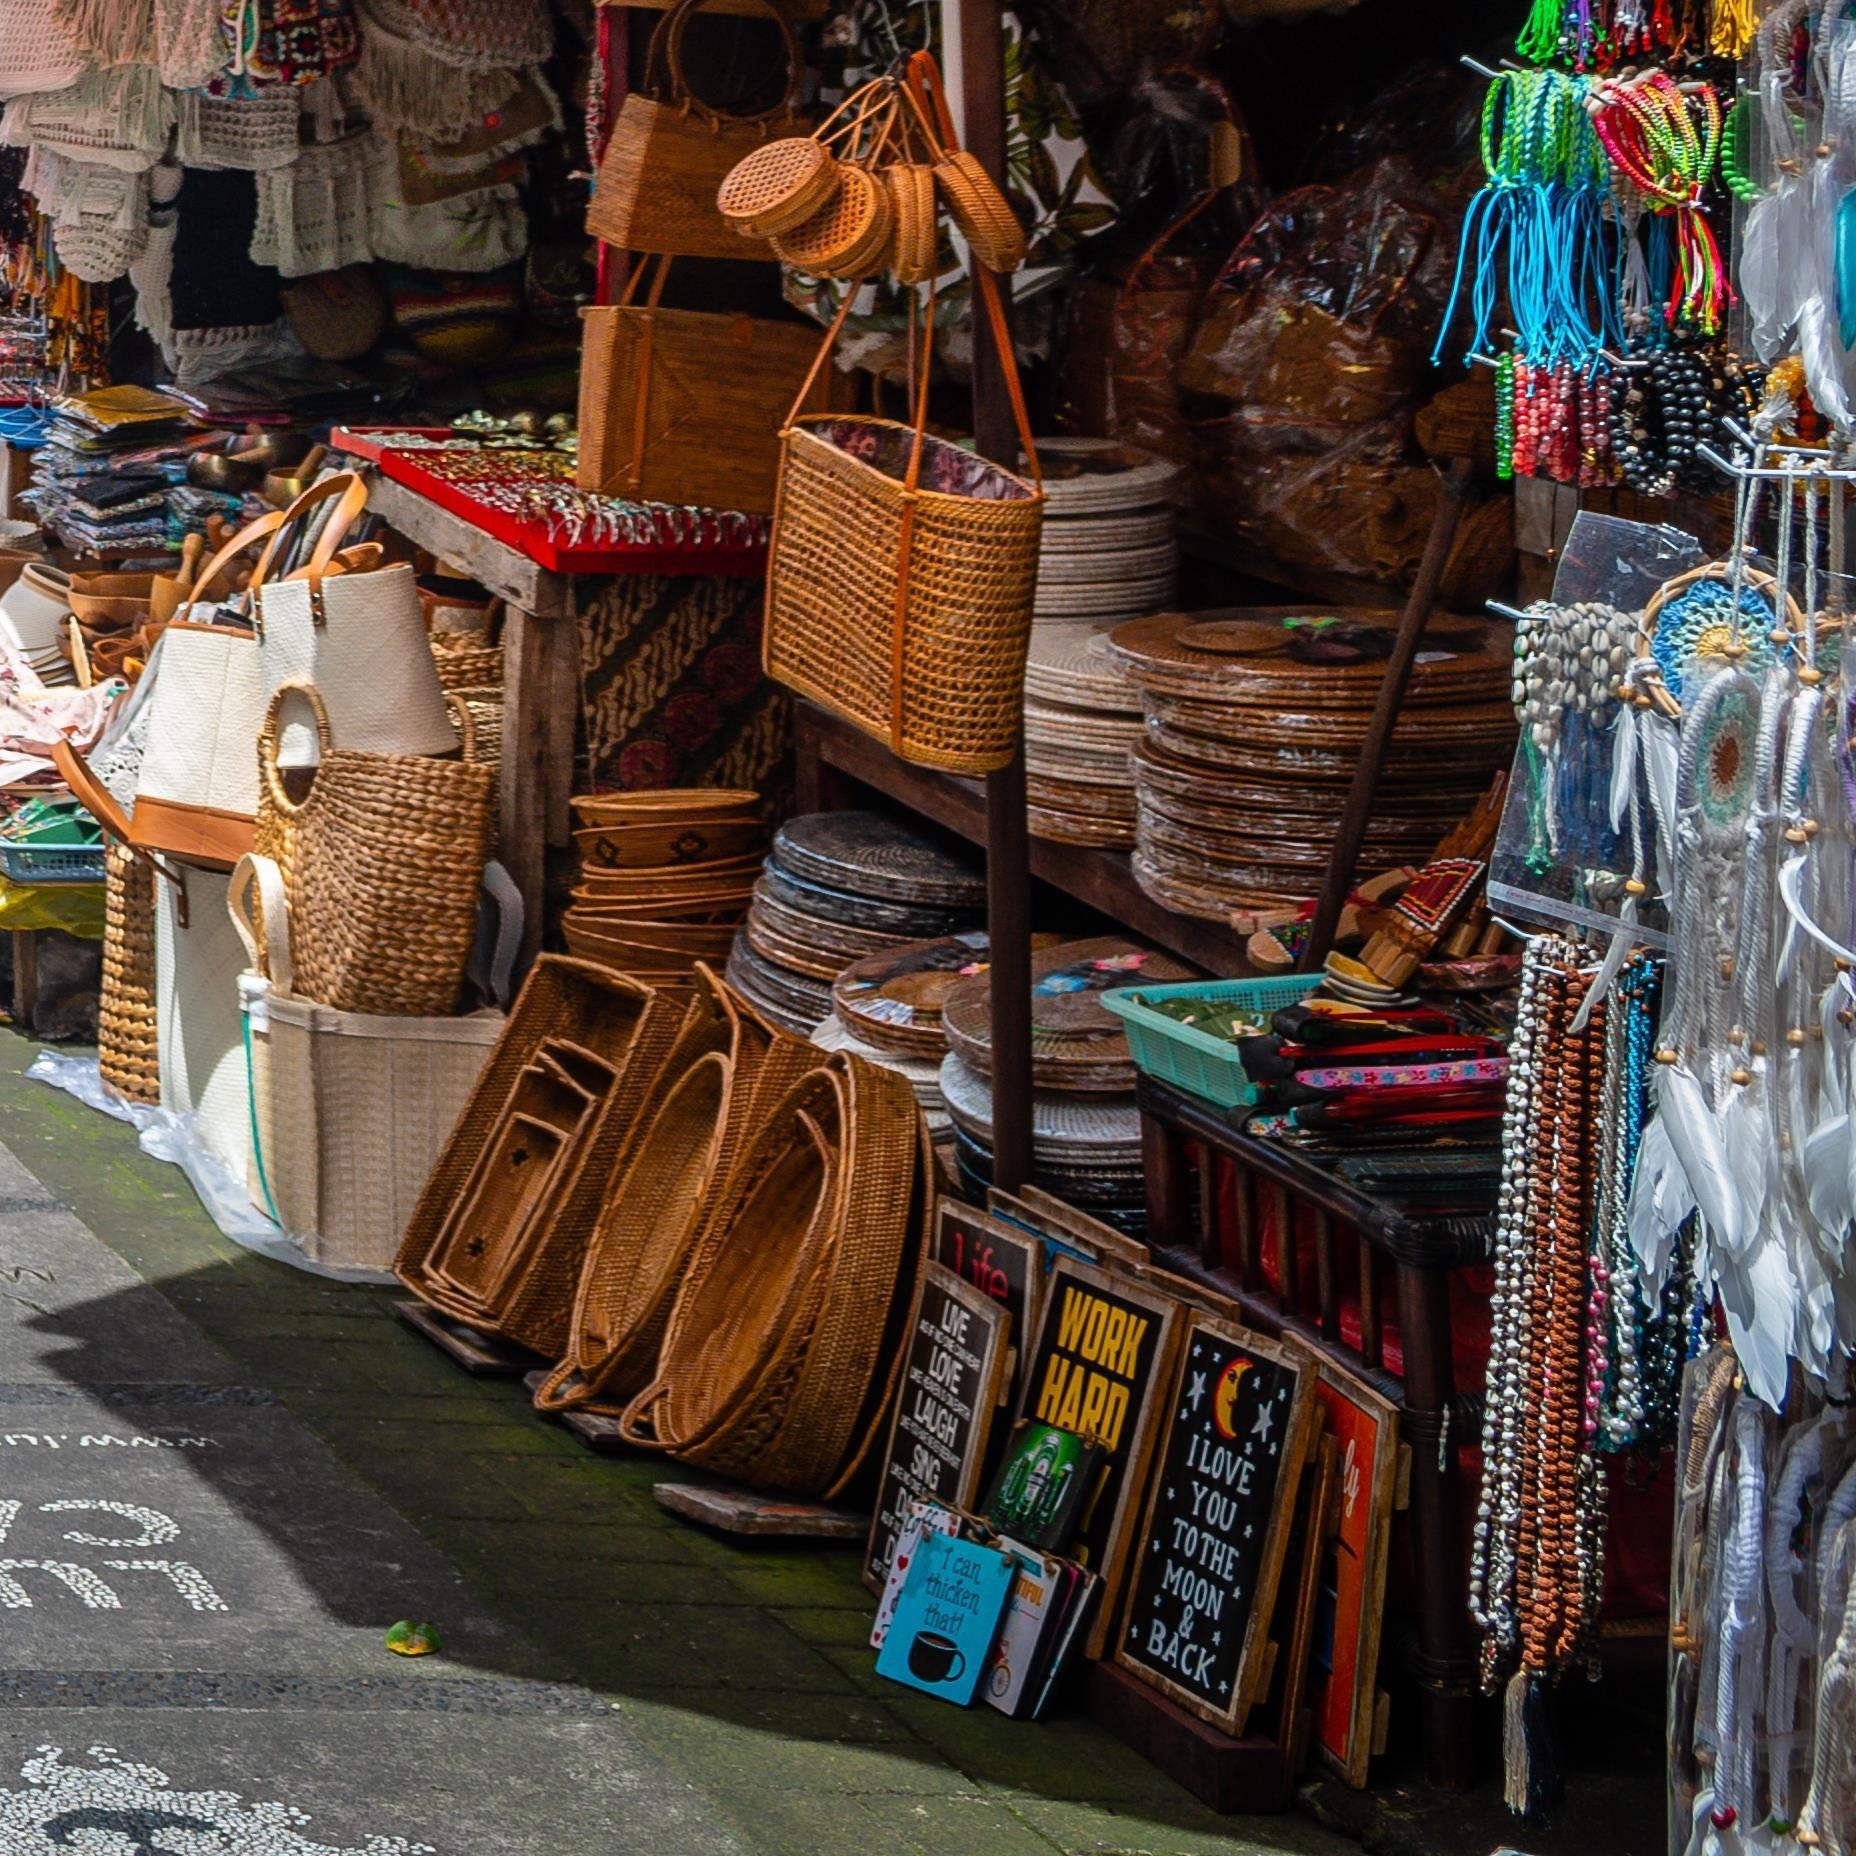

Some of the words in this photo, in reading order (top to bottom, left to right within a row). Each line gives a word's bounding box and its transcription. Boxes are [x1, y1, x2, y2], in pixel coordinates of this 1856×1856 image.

[940, 1299, 972, 1346] LIVE
[1056, 1285, 1149, 1380] WORK
[929, 1344, 965, 1395] LOVE
[913, 1389, 959, 1448] LAUGH
[1035, 1352, 1131, 1454] HARD
[910, 1443, 942, 1492] SING
[1185, 1433, 1200, 1468] I
[1197, 1438, 1257, 1496] LOVE
[1191, 1480, 1239, 1533] YOU
[941, 1546, 955, 1571] I
[952, 1554, 984, 1586] can
[1172, 1516, 1200, 1559] TO
[1198, 1531, 1241, 1583] THE
[924, 1571, 981, 1616] thicken
[1160, 1558, 1226, 1621] MOON
[922, 1602, 966, 1637] that!
[1177, 1603, 1195, 1641] &
[1145, 1617, 1218, 1690] BACK
